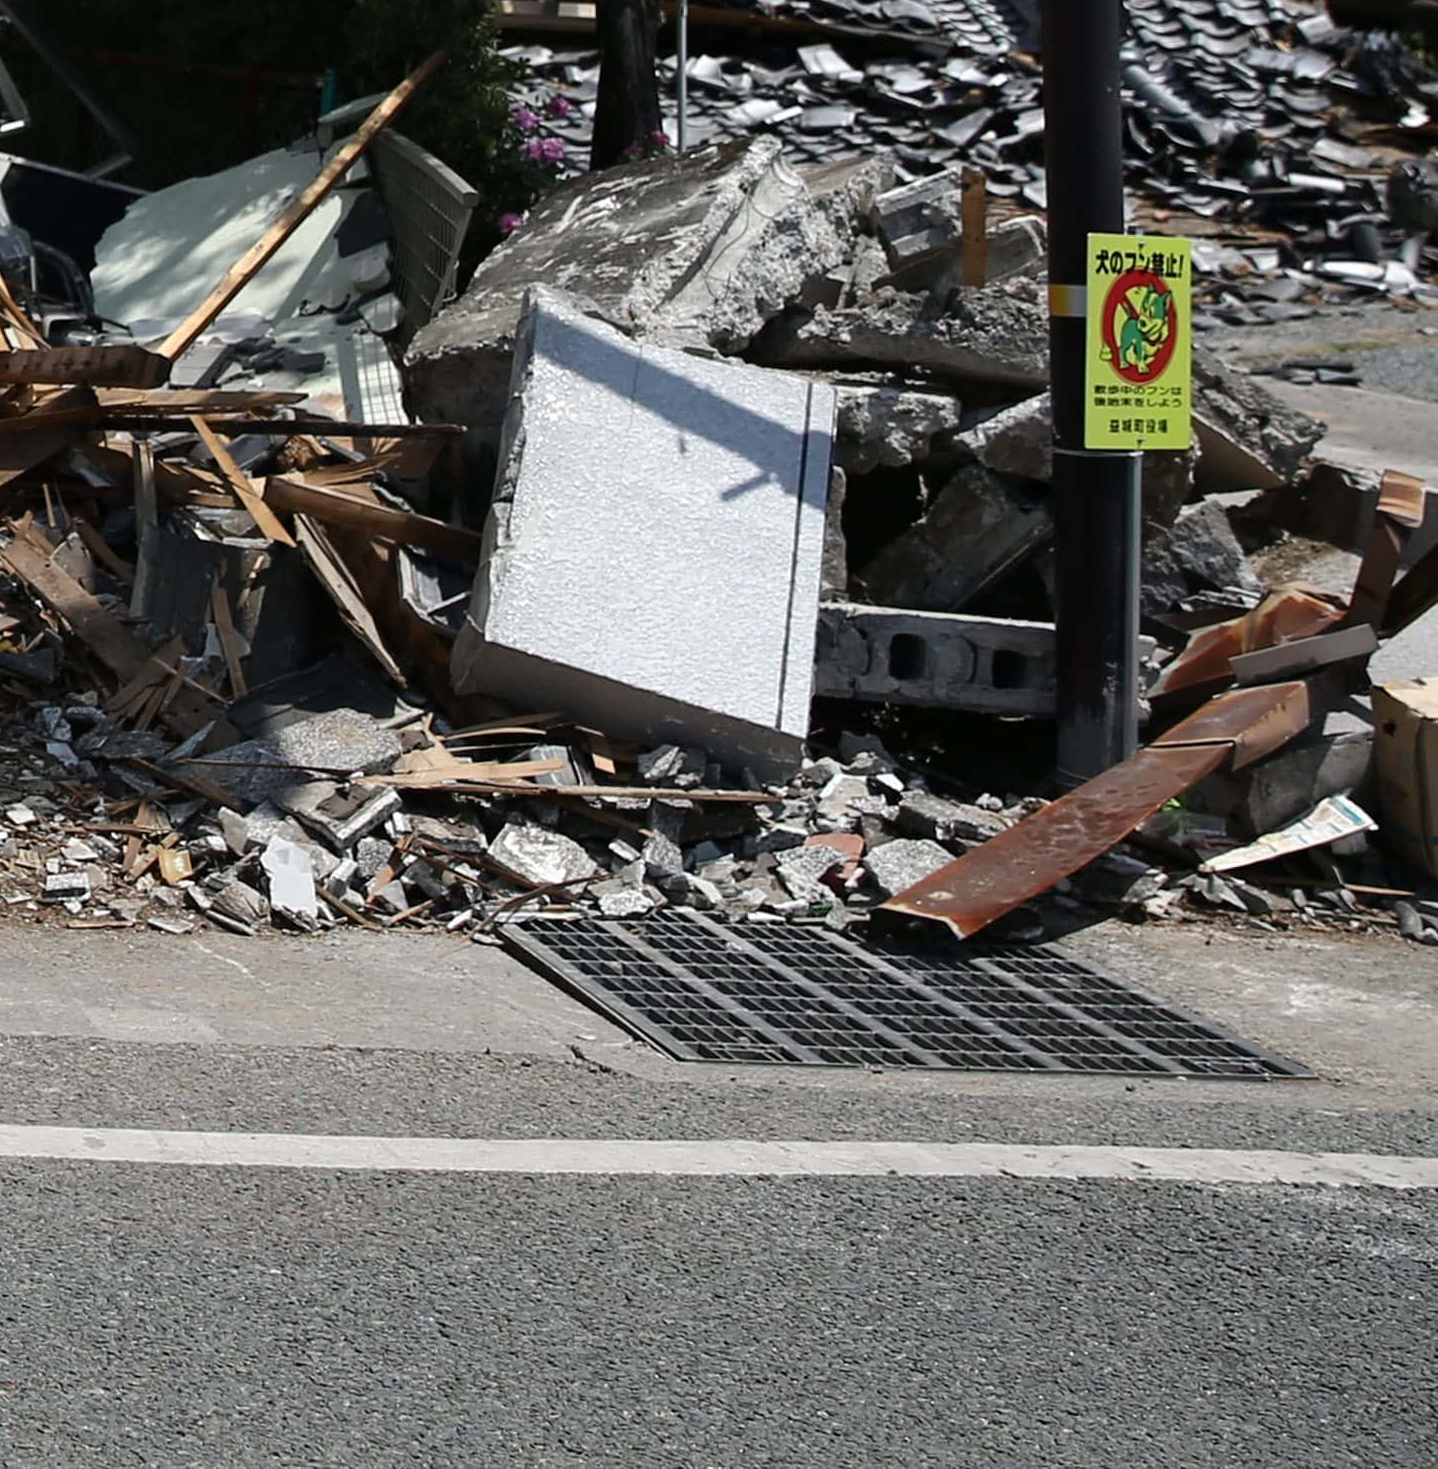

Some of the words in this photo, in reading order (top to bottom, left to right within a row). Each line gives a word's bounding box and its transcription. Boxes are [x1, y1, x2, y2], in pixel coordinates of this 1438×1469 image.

[1095, 249, 1184, 278] 犬のフン禁止!
